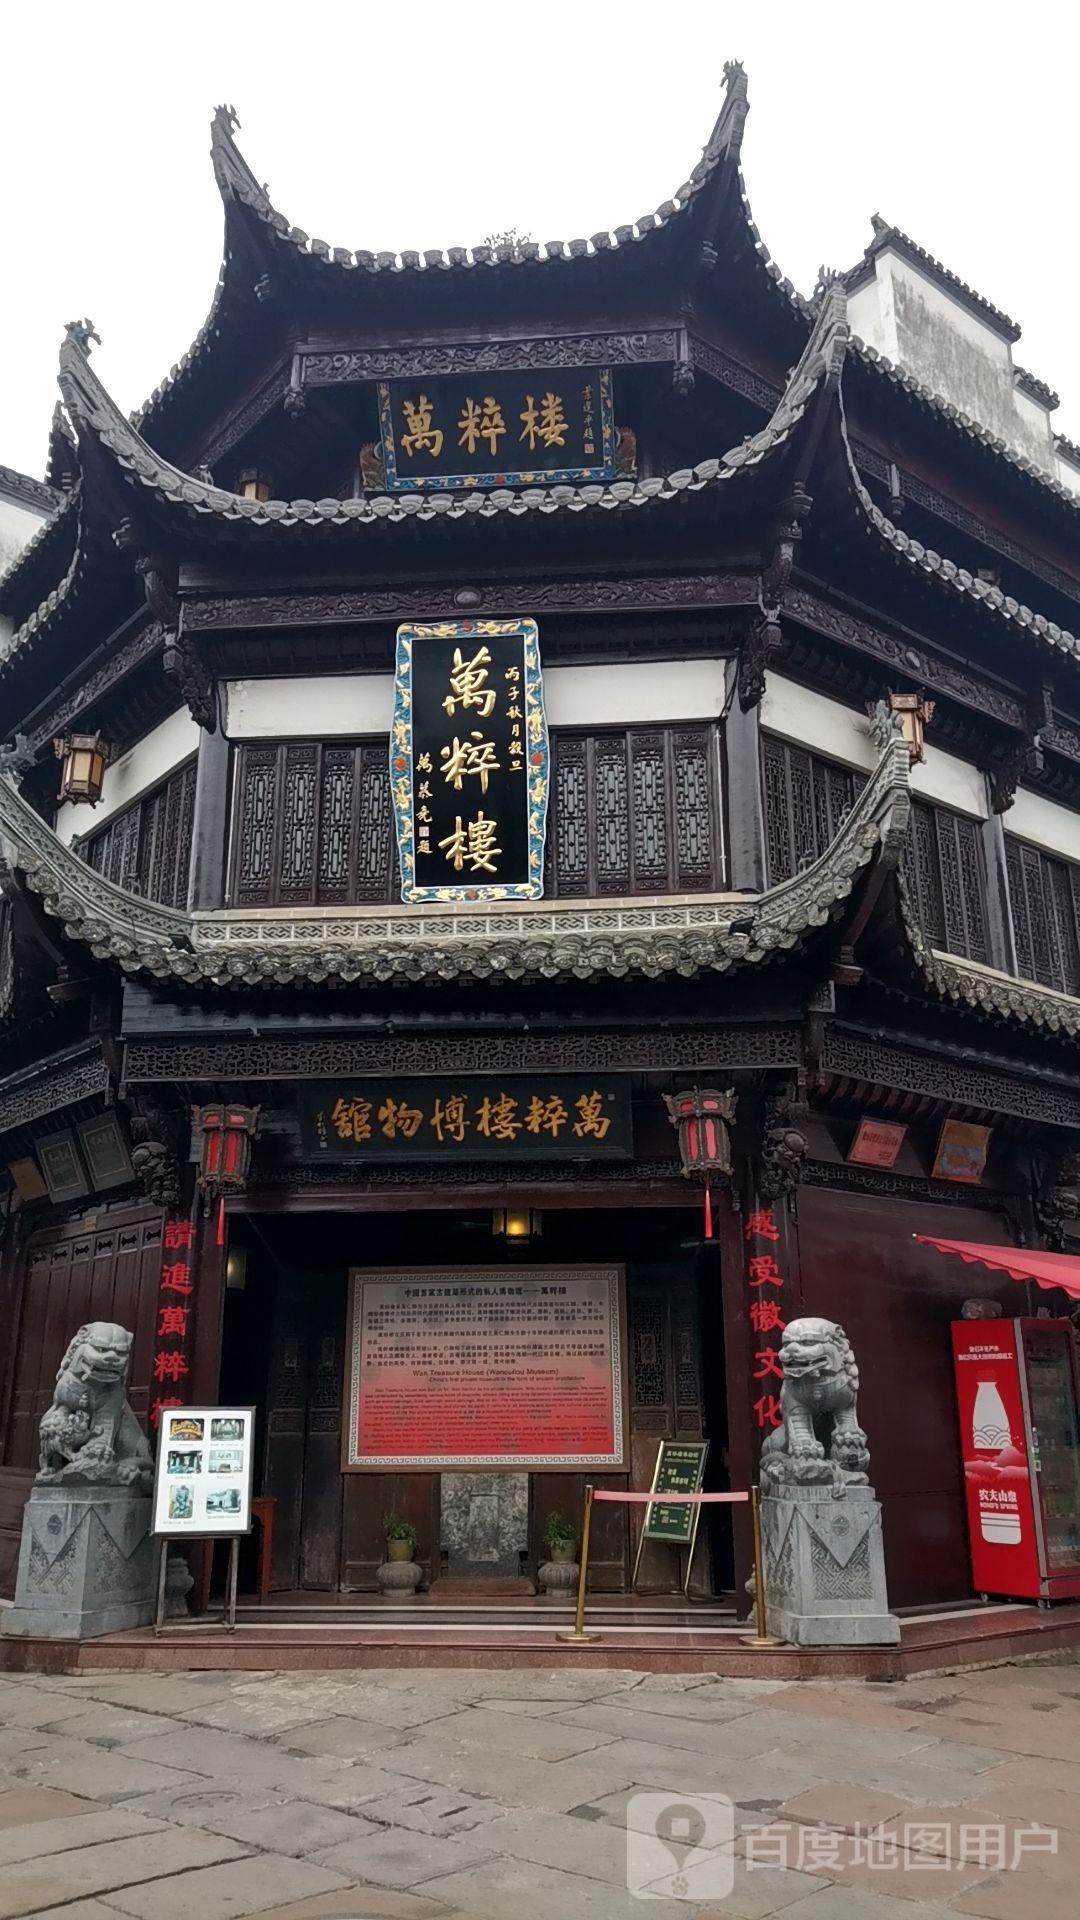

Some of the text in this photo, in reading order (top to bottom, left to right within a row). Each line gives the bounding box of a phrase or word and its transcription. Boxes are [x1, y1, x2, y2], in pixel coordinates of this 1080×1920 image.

[401, 392, 570, 457] 萬粹楼
[438, 646, 502, 873] 萬粹樓
[744, 1209, 787, 1427] 感受徽文化
[978, 1489, 1018, 1503] 农夫山泉
